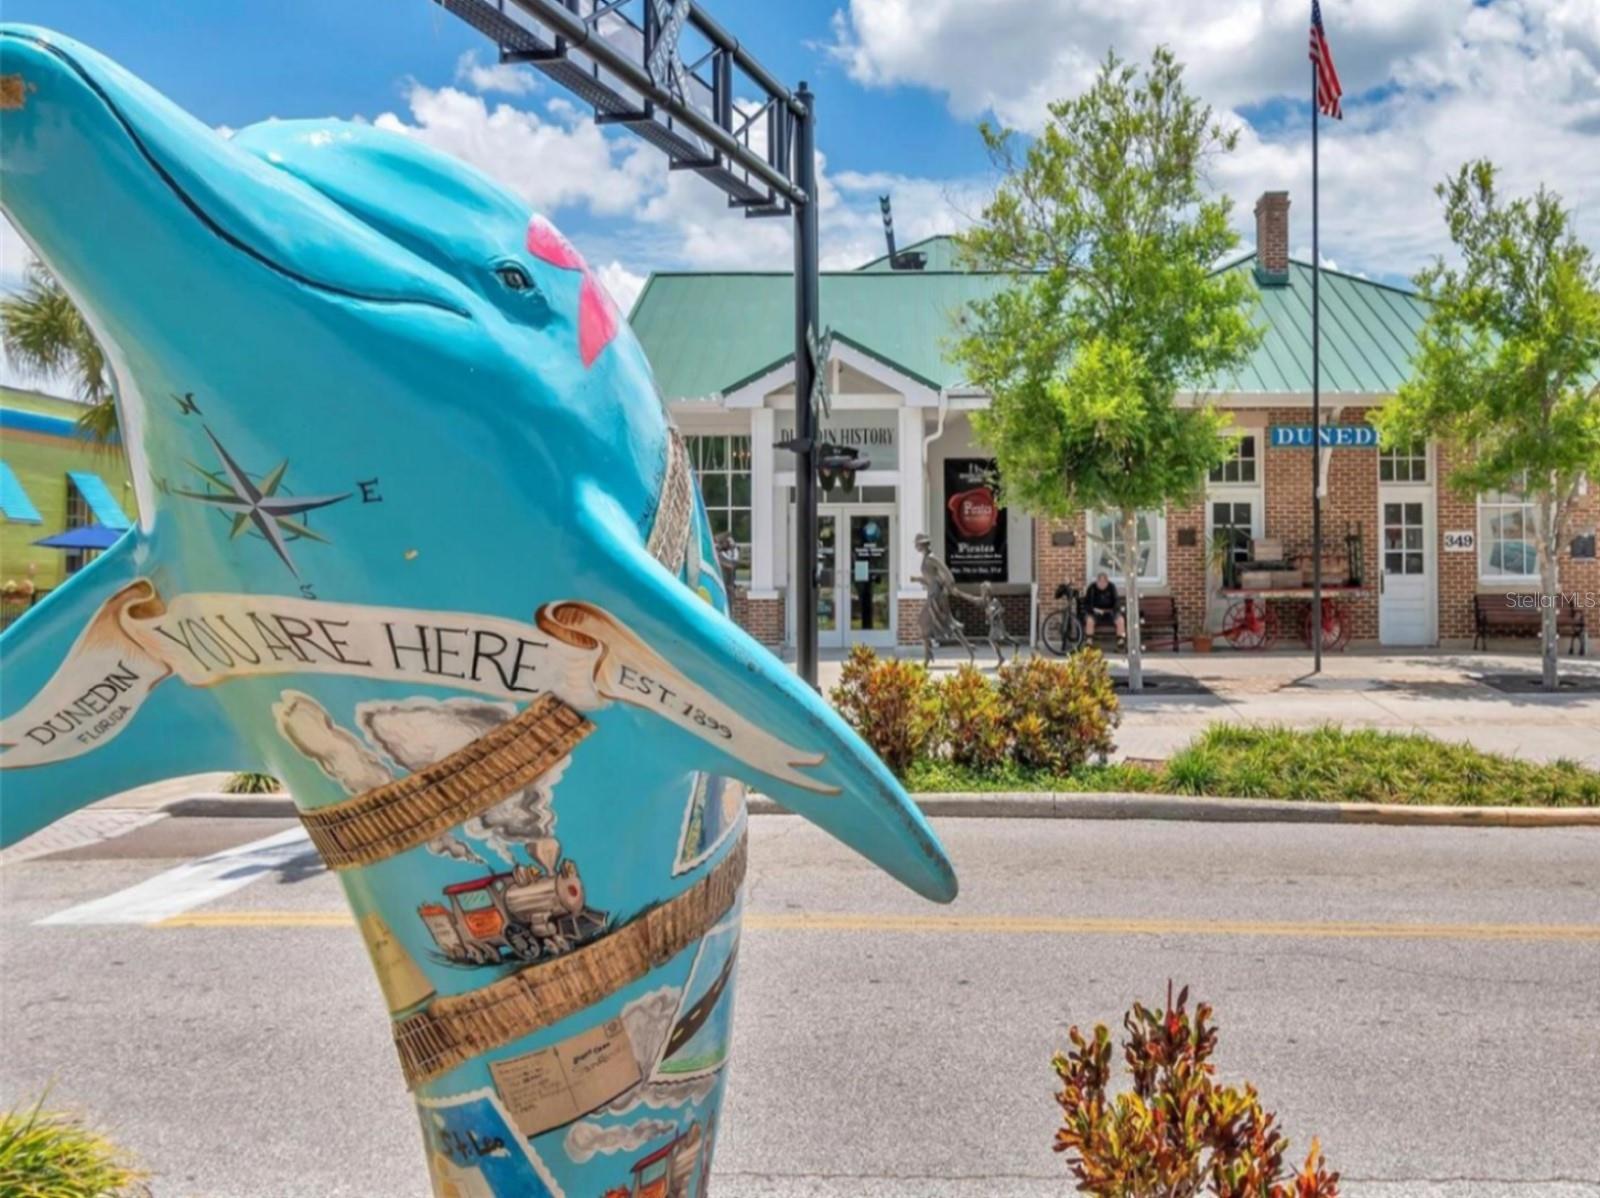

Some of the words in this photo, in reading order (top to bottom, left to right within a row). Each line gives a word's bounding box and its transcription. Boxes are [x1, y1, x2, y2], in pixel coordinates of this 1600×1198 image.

[841, 427, 895, 445] HISTORY
[357, 477, 383, 503] E
[1446, 534, 1473, 548] 349
[300, 584, 317, 600] S
[154, 614, 261, 672] YOU
[247, 612, 372, 667] ARE
[382, 622, 549, 693] HERE
[25, 660, 140, 746] DUNEDIN
[77, 705, 131, 744] FLORIDA
[682, 702, 733, 740] 1899
